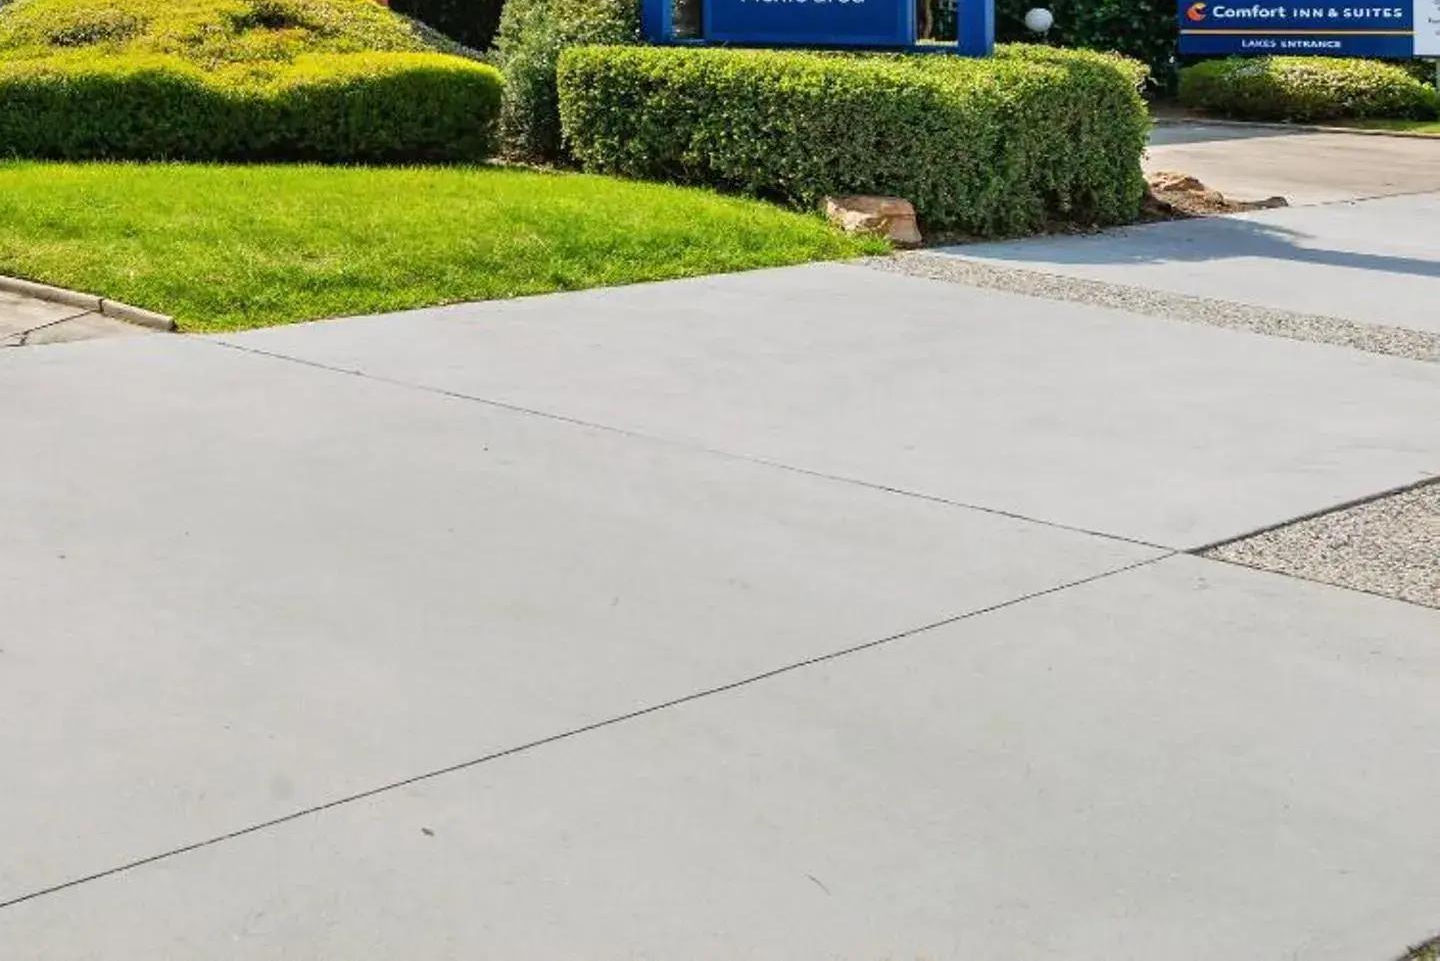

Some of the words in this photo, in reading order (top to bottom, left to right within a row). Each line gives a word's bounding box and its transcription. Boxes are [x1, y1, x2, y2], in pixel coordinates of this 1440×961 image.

[1212, 3, 1286, 19] Comfort
[1293, 7, 1324, 19] INN
[1327, 7, 1339, 19] &
[1343, 7, 1403, 19] SUITES
[1241, 39, 1277, 49] LAKES
[1280, 39, 1342, 49] ENTRANCE
